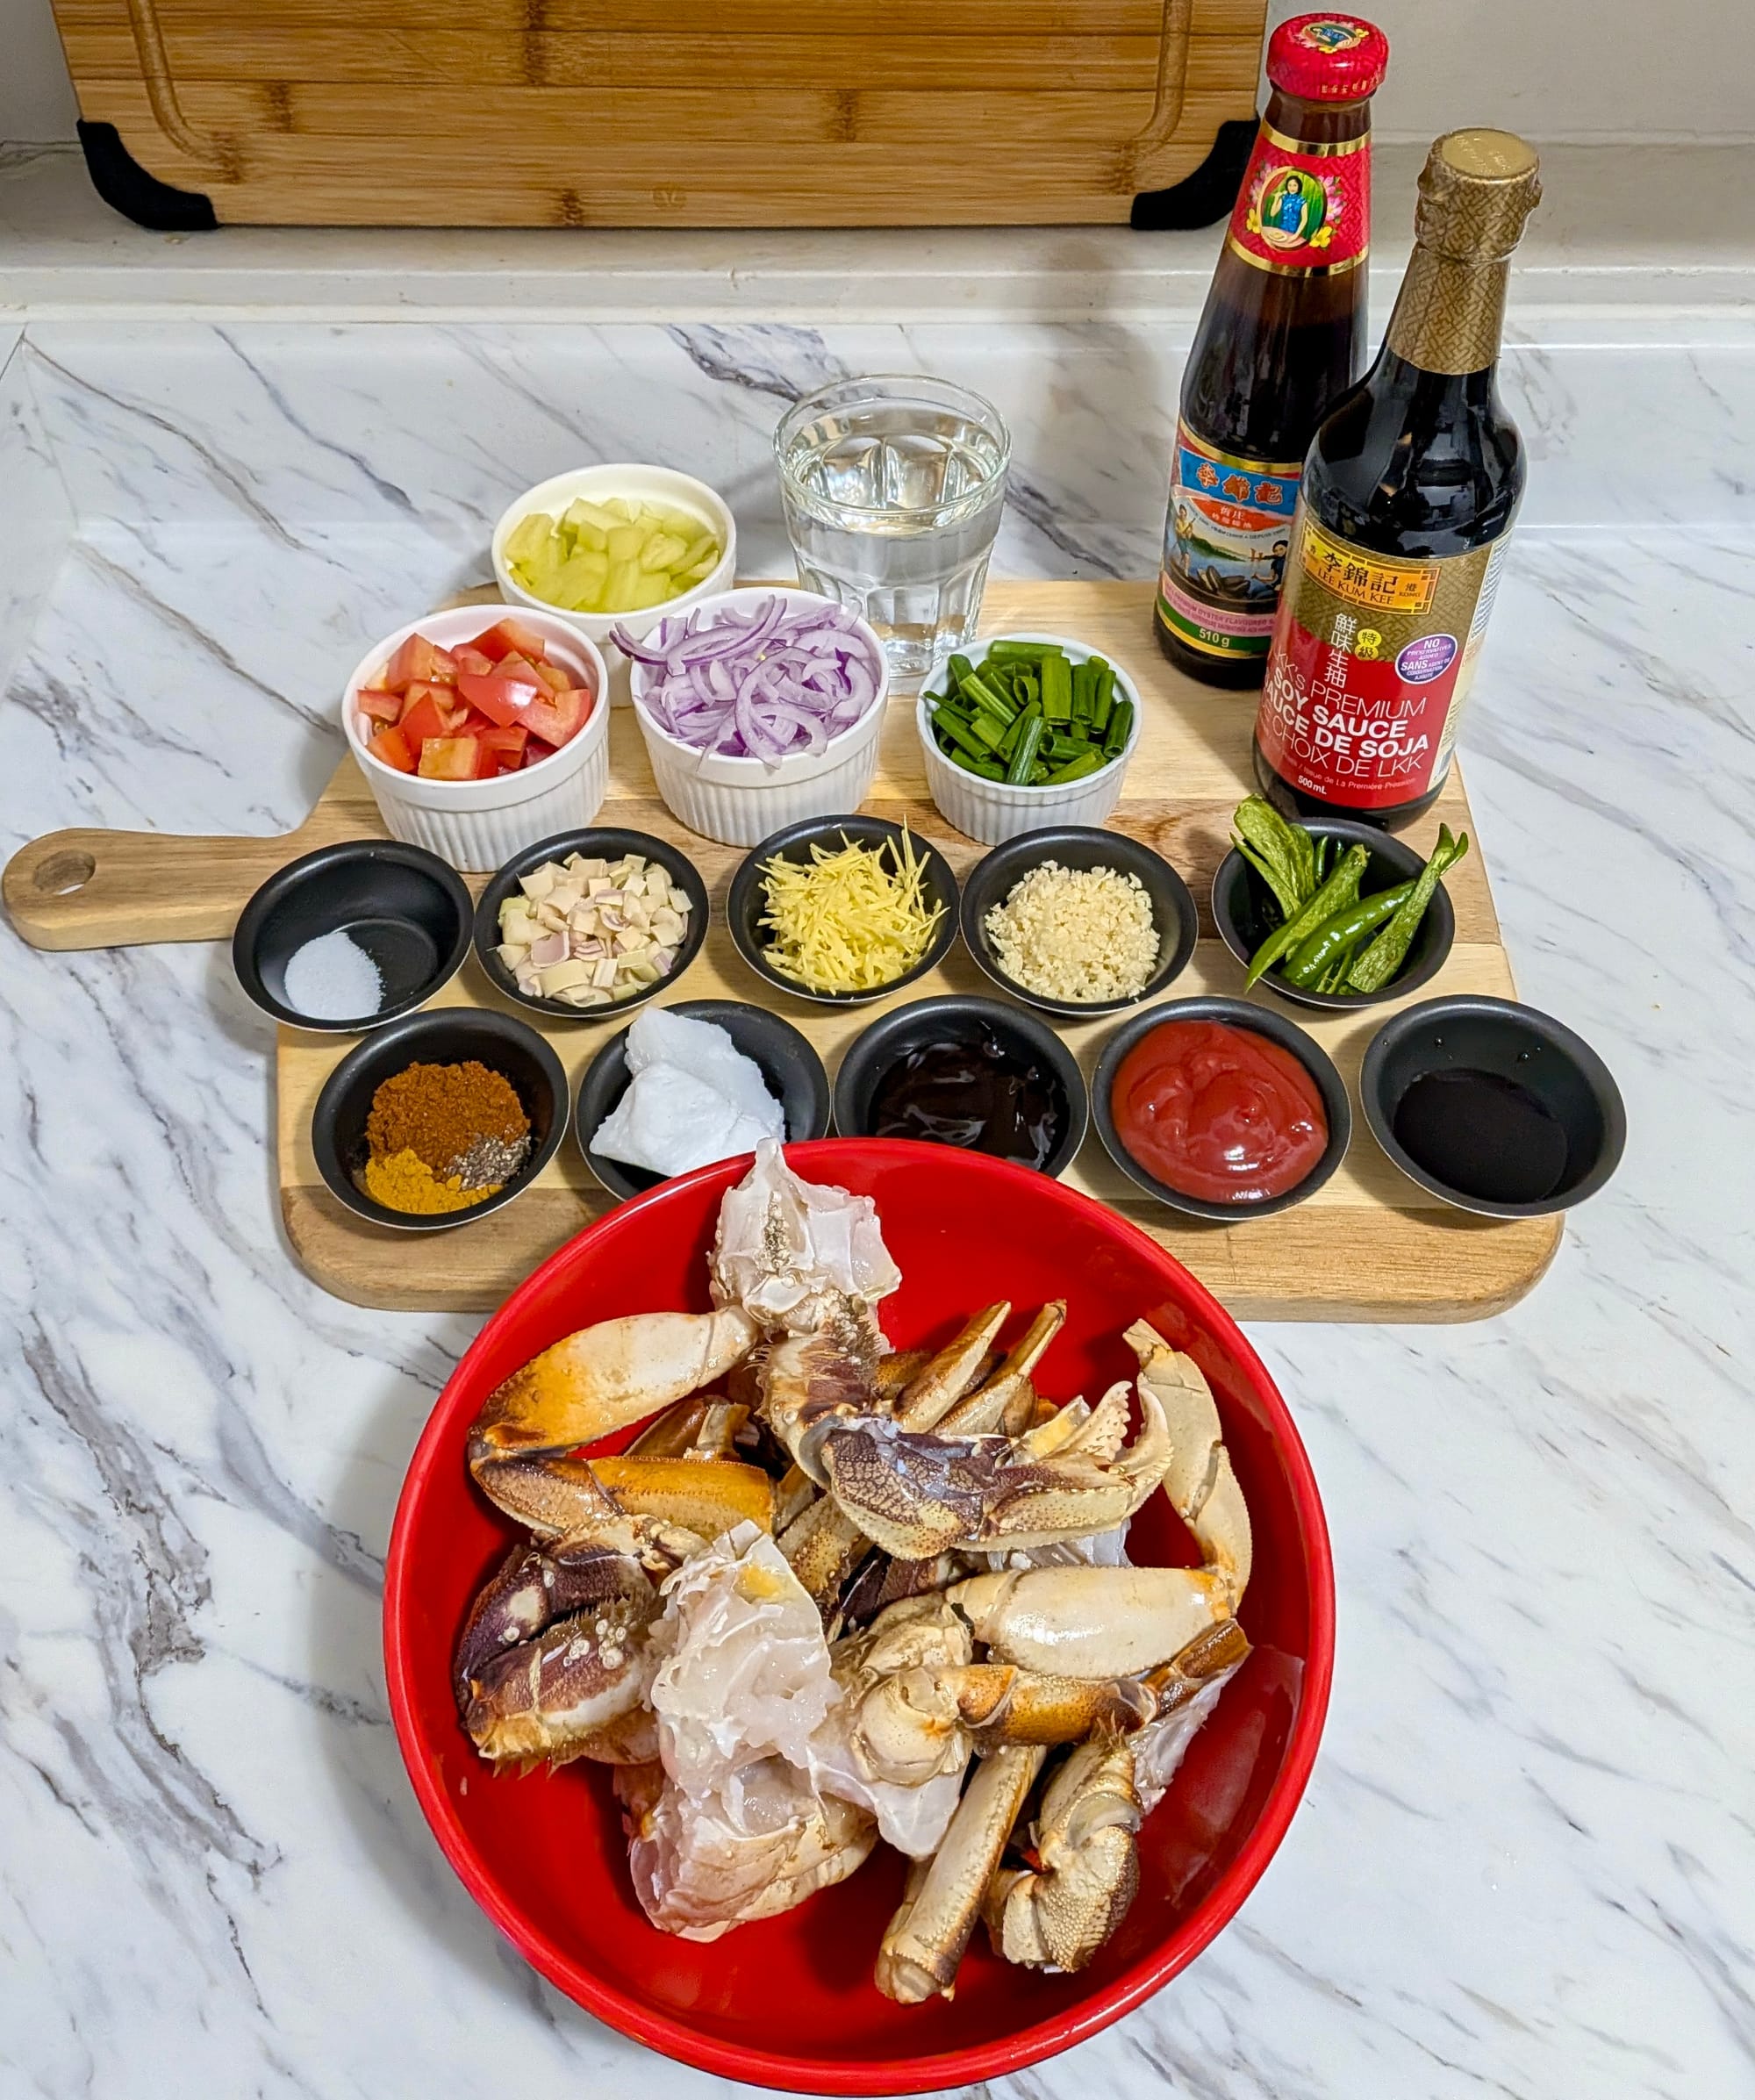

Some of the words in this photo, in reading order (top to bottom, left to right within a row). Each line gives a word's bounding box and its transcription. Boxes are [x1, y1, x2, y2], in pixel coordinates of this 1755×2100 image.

[1317, 567, 1335, 584] LEE
[1337, 580, 1365, 598] KUM
[1370, 593, 1394, 605] KEE
[1322, 551, 1399, 594] 李錦記
[1198, 608, 1223, 622] OYSTER
[1199, 627, 1220, 643] 510
[1221, 637, 1230, 648] g
[1324, 613, 1357, 689] 鮮味生抽
[1358, 631, 1378, 659] 特級
[1424, 638, 1440, 649] NO
[1400, 659, 1428, 671] SANS
[1264, 668, 1310, 738] SAUCE
[1314, 727, 1353, 755] DE
[1358, 734, 1429, 759] SOJA
[1273, 666, 1308, 712] SOY
[1313, 705, 1408, 739] SAUCE
[1310, 679, 1427, 720] PREMIUM
[1272, 715, 1330, 769] CHOIX
[1336, 756, 1372, 778] DE
[1378, 753, 1426, 778] LKK
[1336, 778, 1346, 787] La
